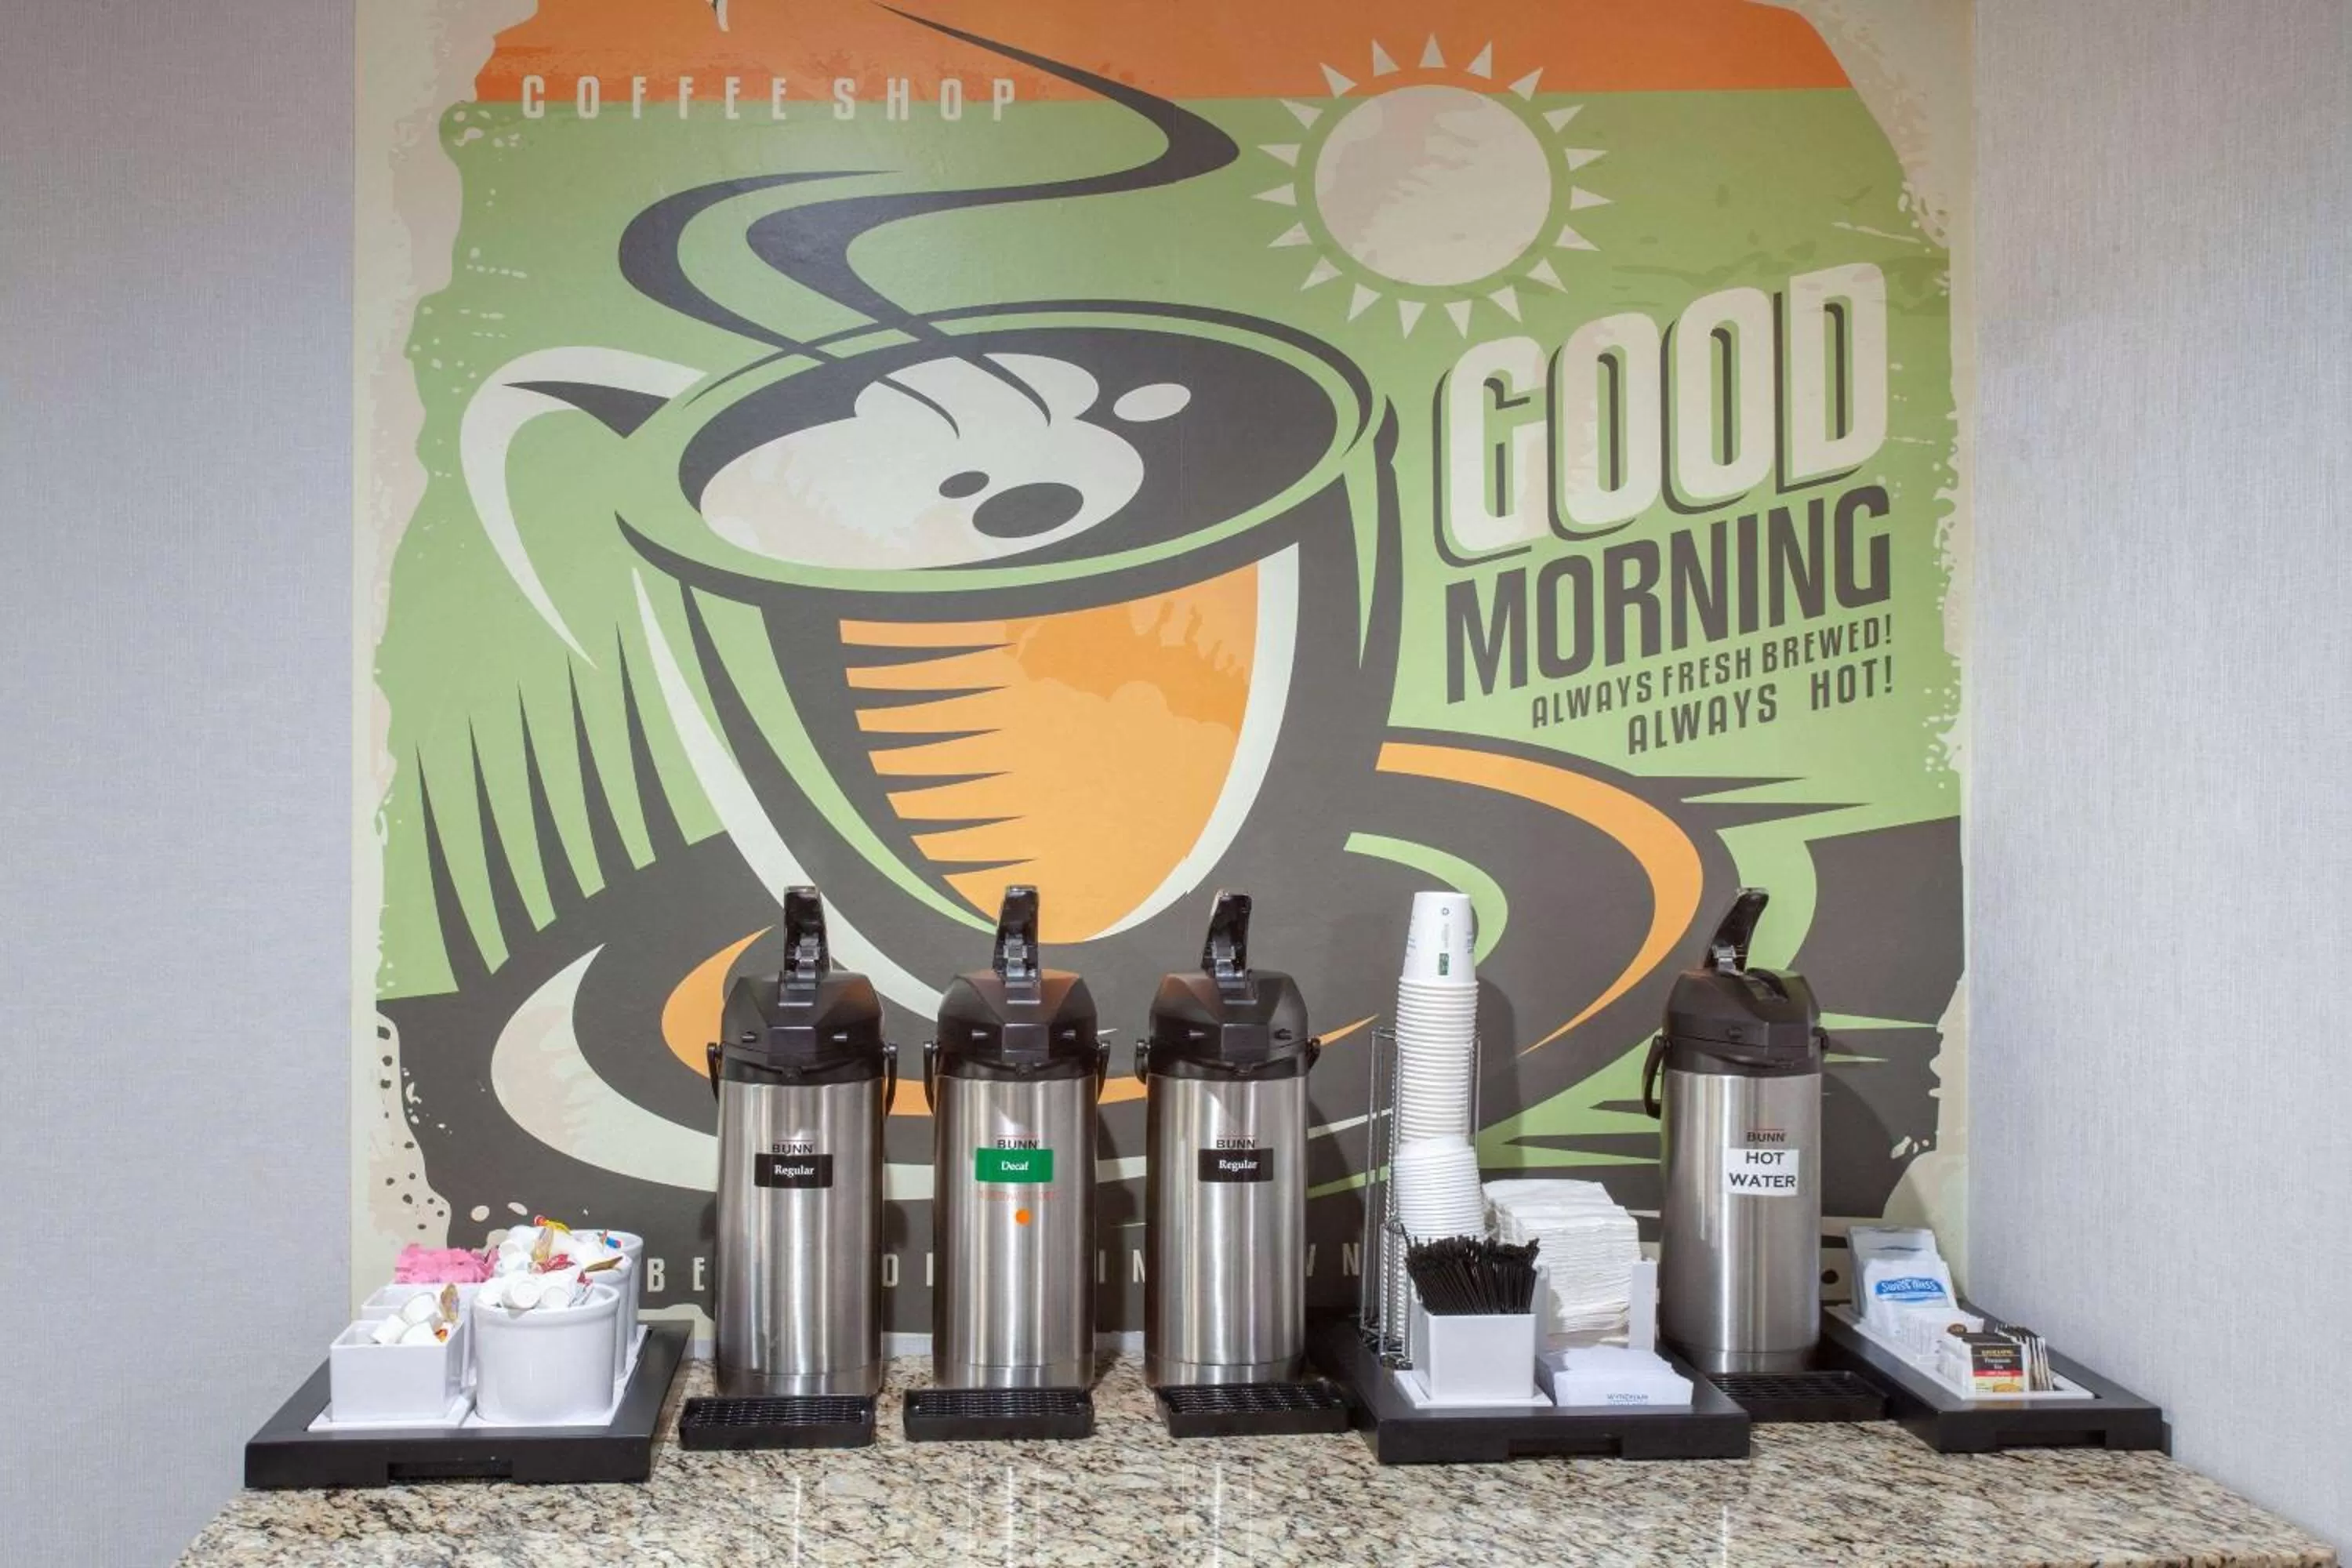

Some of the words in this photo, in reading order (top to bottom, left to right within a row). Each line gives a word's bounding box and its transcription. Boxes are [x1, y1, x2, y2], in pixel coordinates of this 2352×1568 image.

[521, 74, 786, 121] COFFEE
[833, 77, 1016, 122] SHOP
[1432, 263, 1888, 568] GOOD
[1445, 485, 1891, 705] MORNING
[1531, 670, 1653, 729] ALWAYS
[1663, 647, 1751, 698] FRESH
[1762, 613, 1892, 673] BREWED!
[1628, 683, 1778, 755] ALWAYS
[1811, 655, 1893, 711] HOT!
[1746, 1131, 1786, 1142] BUNN
[772, 1144, 814, 1154] BUNN
[997, 1139, 1038, 1149] BUNN
[1216, 1139, 1256, 1149] BUNN
[1745, 1151, 1785, 1165] HOT
[773, 1164, 815, 1178] Regular
[1000, 1160, 1029, 1171] Decaf
[1218, 1160, 1258, 1172] Regular
[1729, 1172, 1796, 1188] WATER
